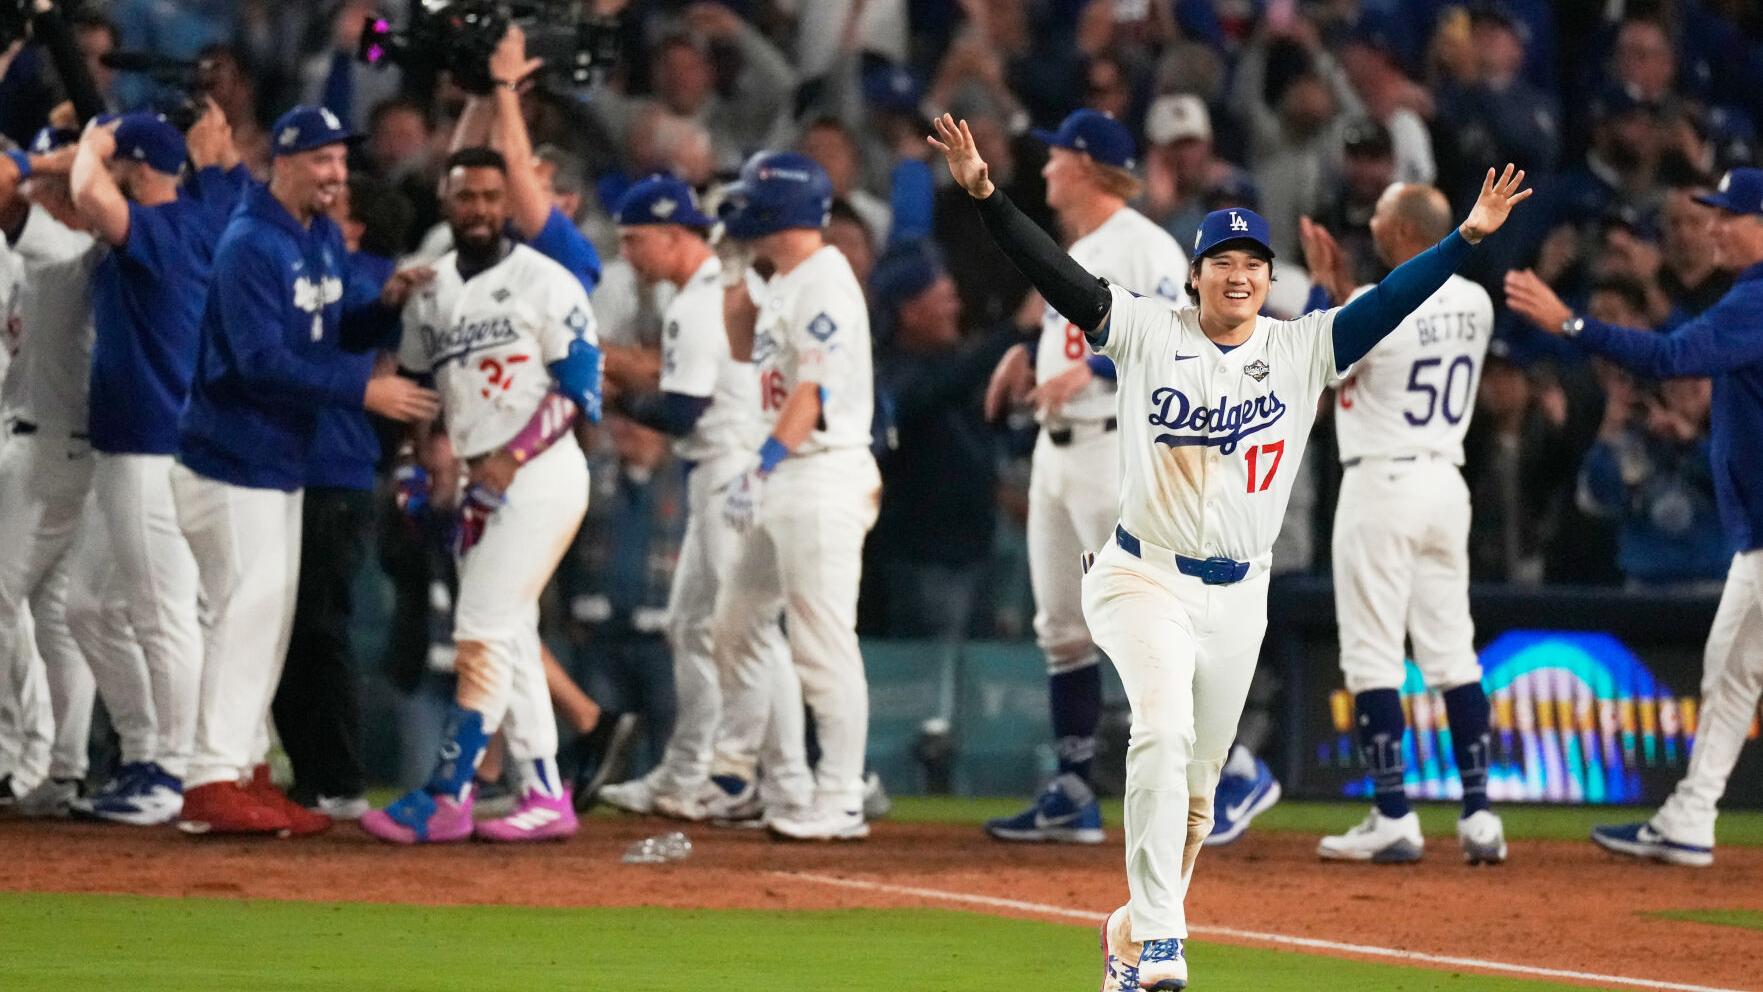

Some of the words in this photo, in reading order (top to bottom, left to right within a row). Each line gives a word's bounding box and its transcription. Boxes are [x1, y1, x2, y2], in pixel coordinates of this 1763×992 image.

[1229, 211, 1249, 231] LA
[1416, 311, 1476, 346] BETTS
[761, 368, 788, 411] 16
[1403, 355, 1473, 426] 50
[1149, 387, 1286, 455] Dodgers
[1245, 440, 1285, 493] 17
